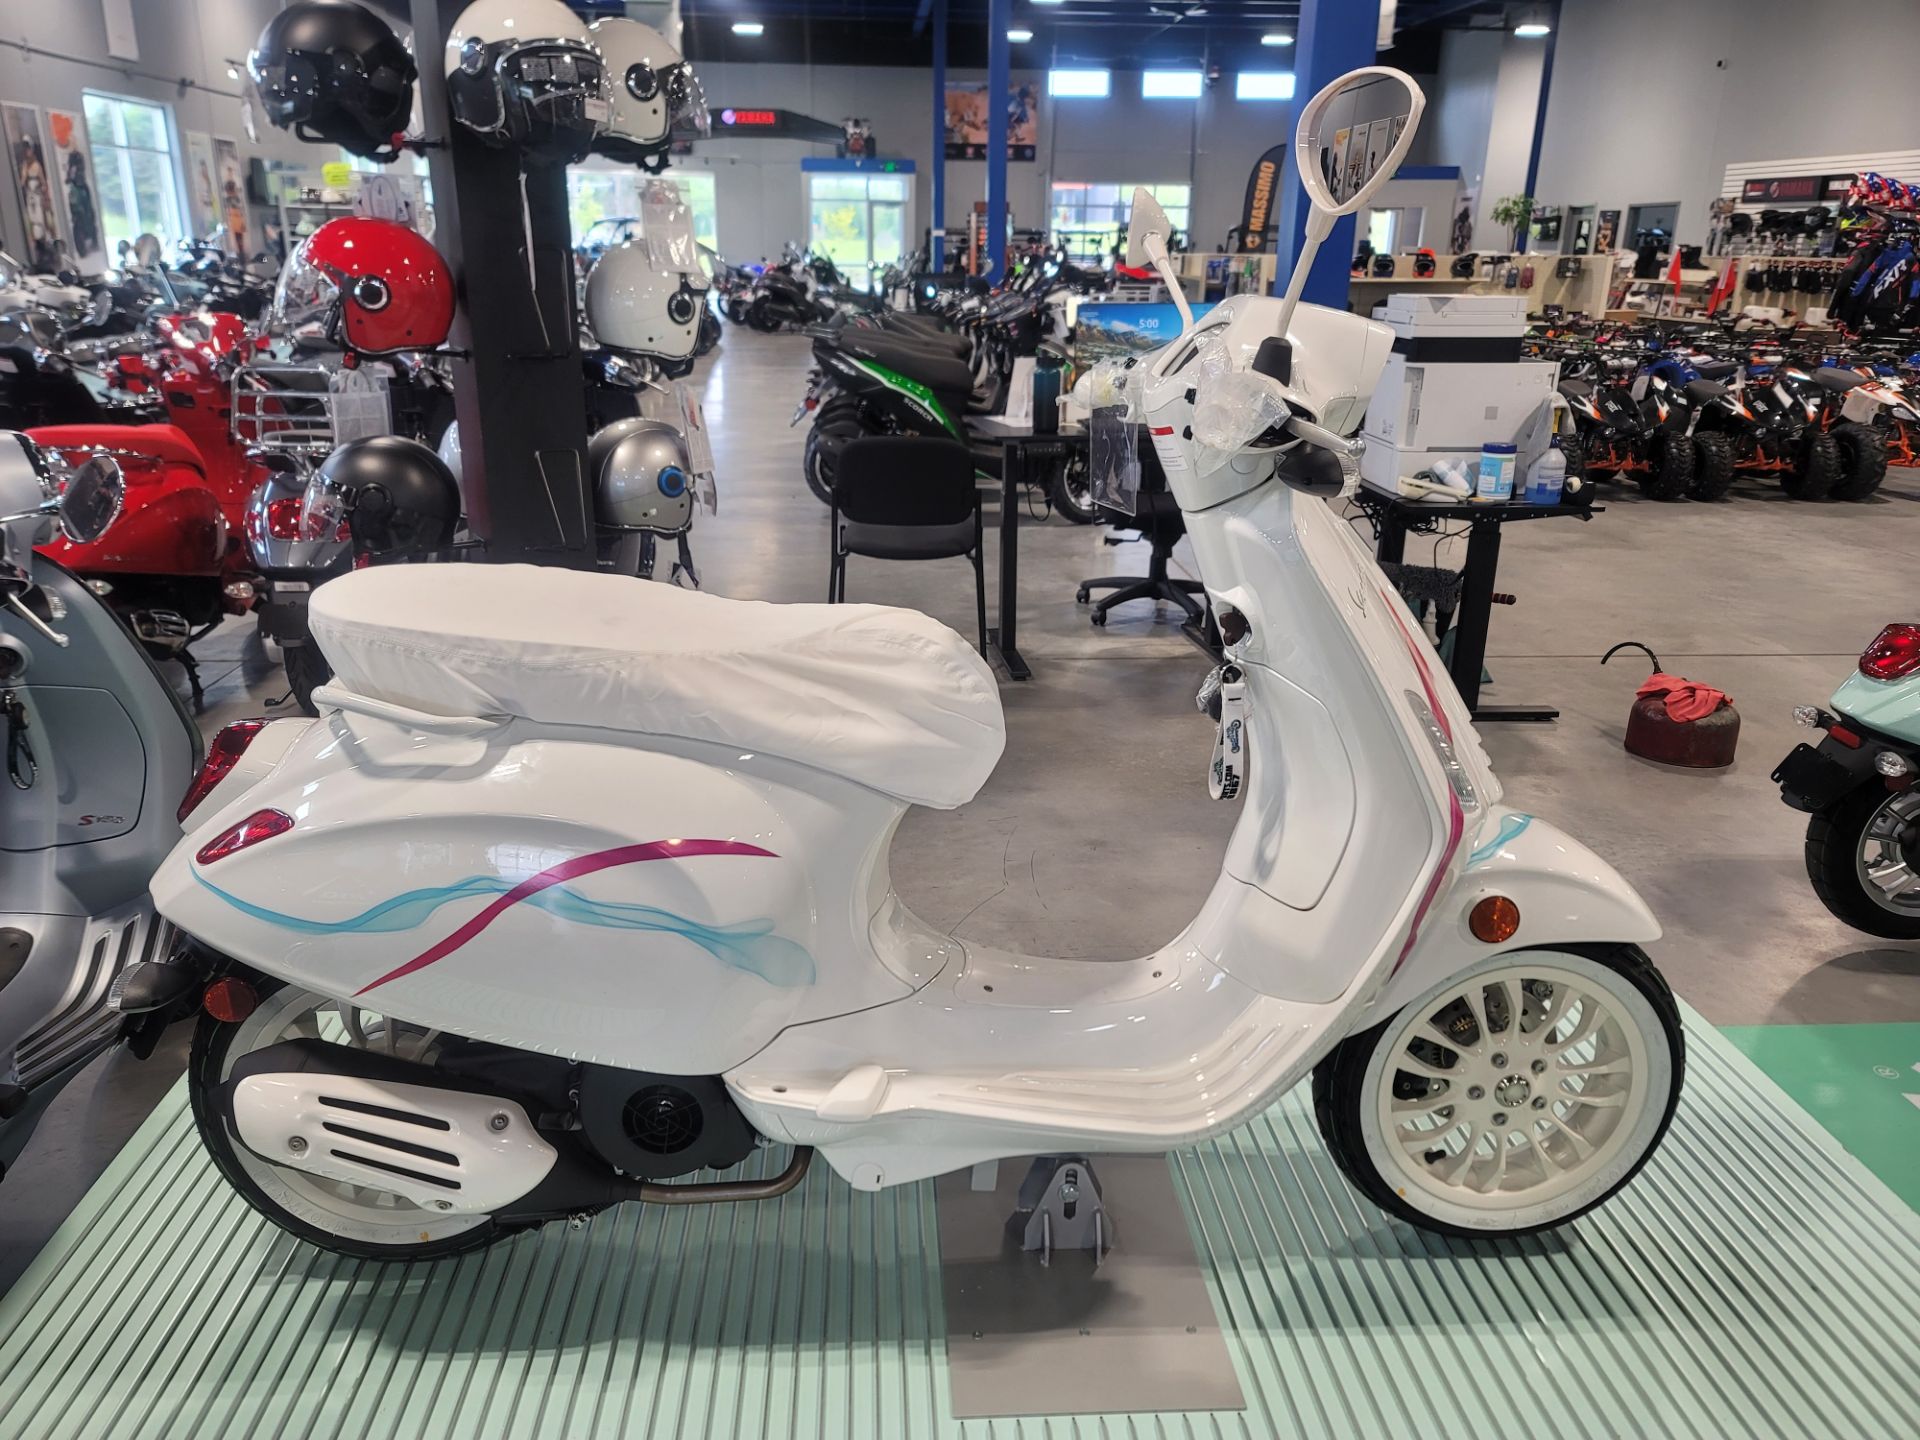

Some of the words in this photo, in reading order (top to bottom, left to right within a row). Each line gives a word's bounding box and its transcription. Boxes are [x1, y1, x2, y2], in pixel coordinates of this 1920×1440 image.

[735, 111, 775, 124] YAMAHA
[1249, 161, 1275, 231] MASSIMO
[1138, 319, 1159, 329] 5:00
